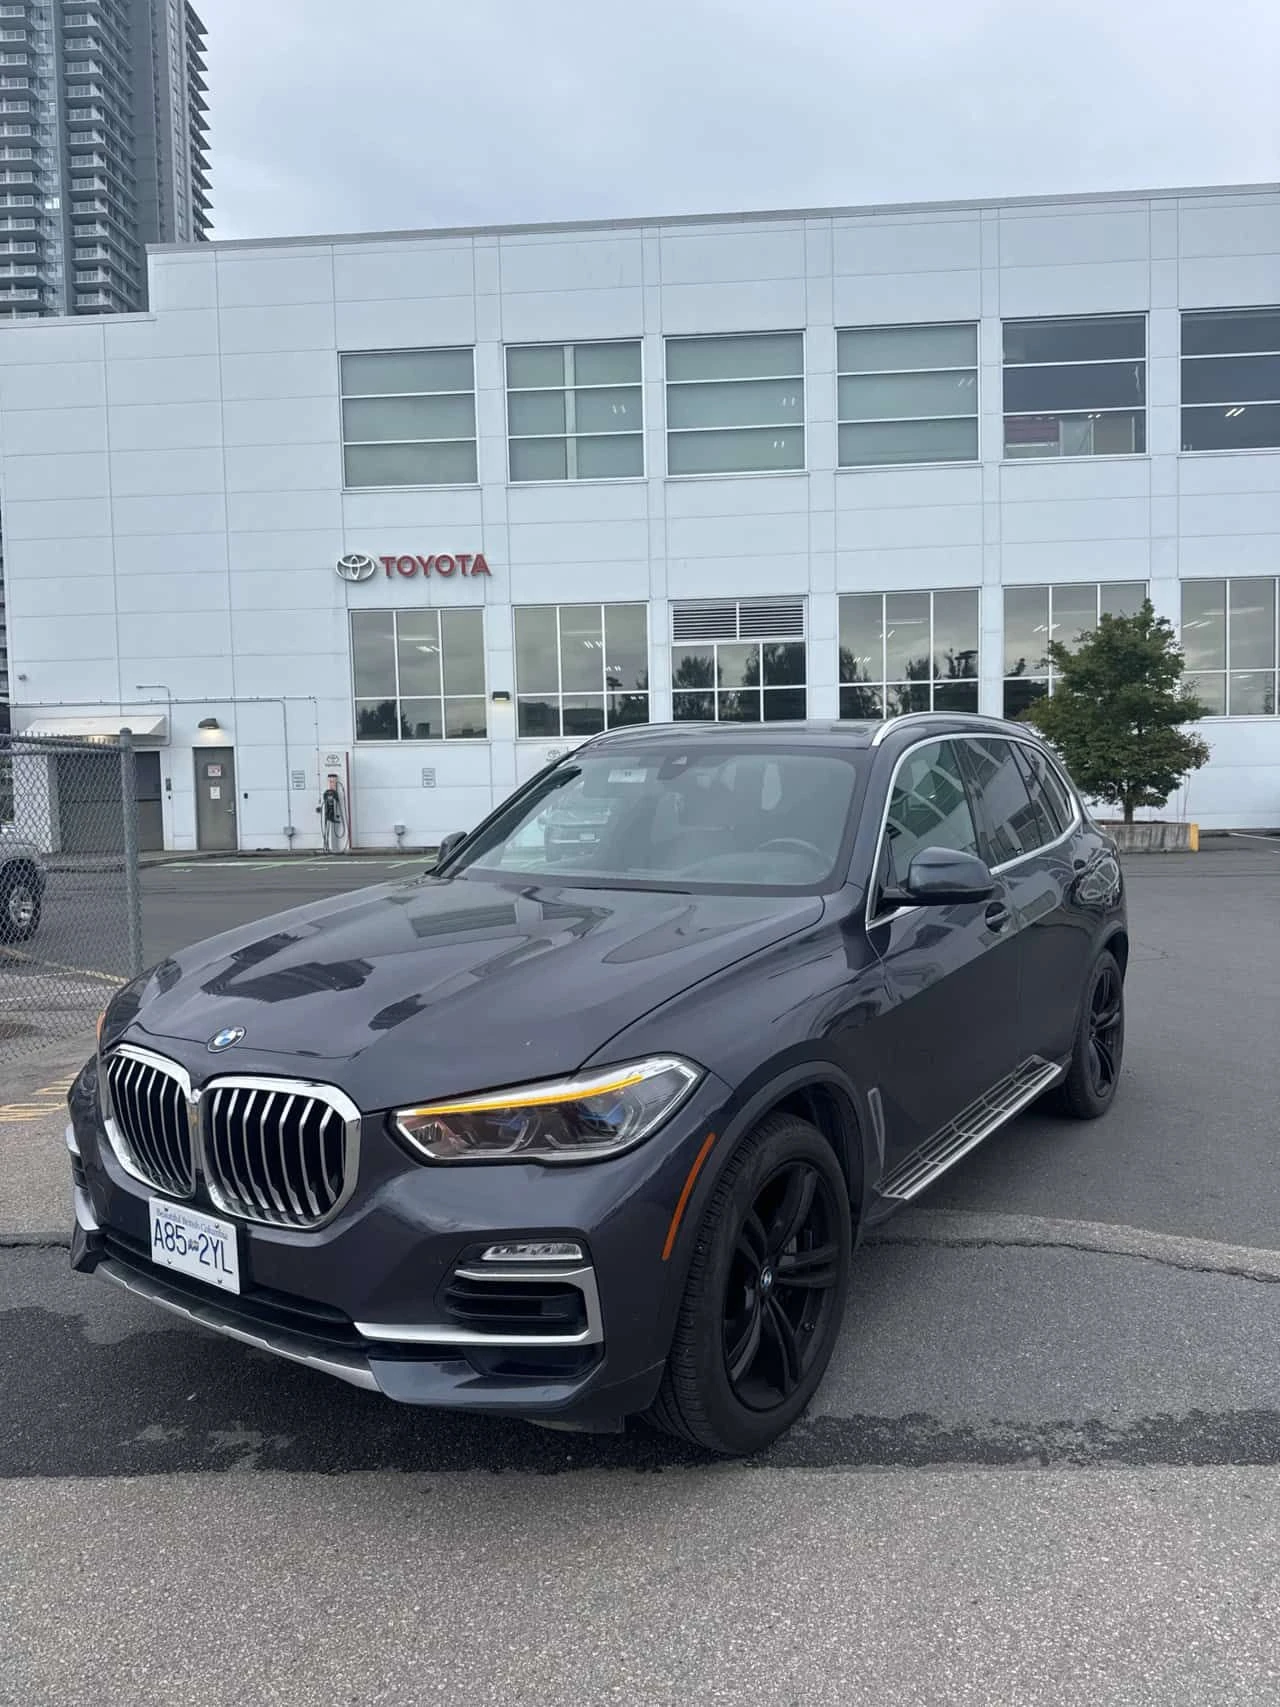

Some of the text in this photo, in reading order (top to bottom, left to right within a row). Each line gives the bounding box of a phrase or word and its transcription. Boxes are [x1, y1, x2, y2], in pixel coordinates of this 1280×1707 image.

[379, 553, 492, 578] TOYOTA
[154, 1218, 187, 1256] A85
[198, 1233, 233, 1274] 2YL
